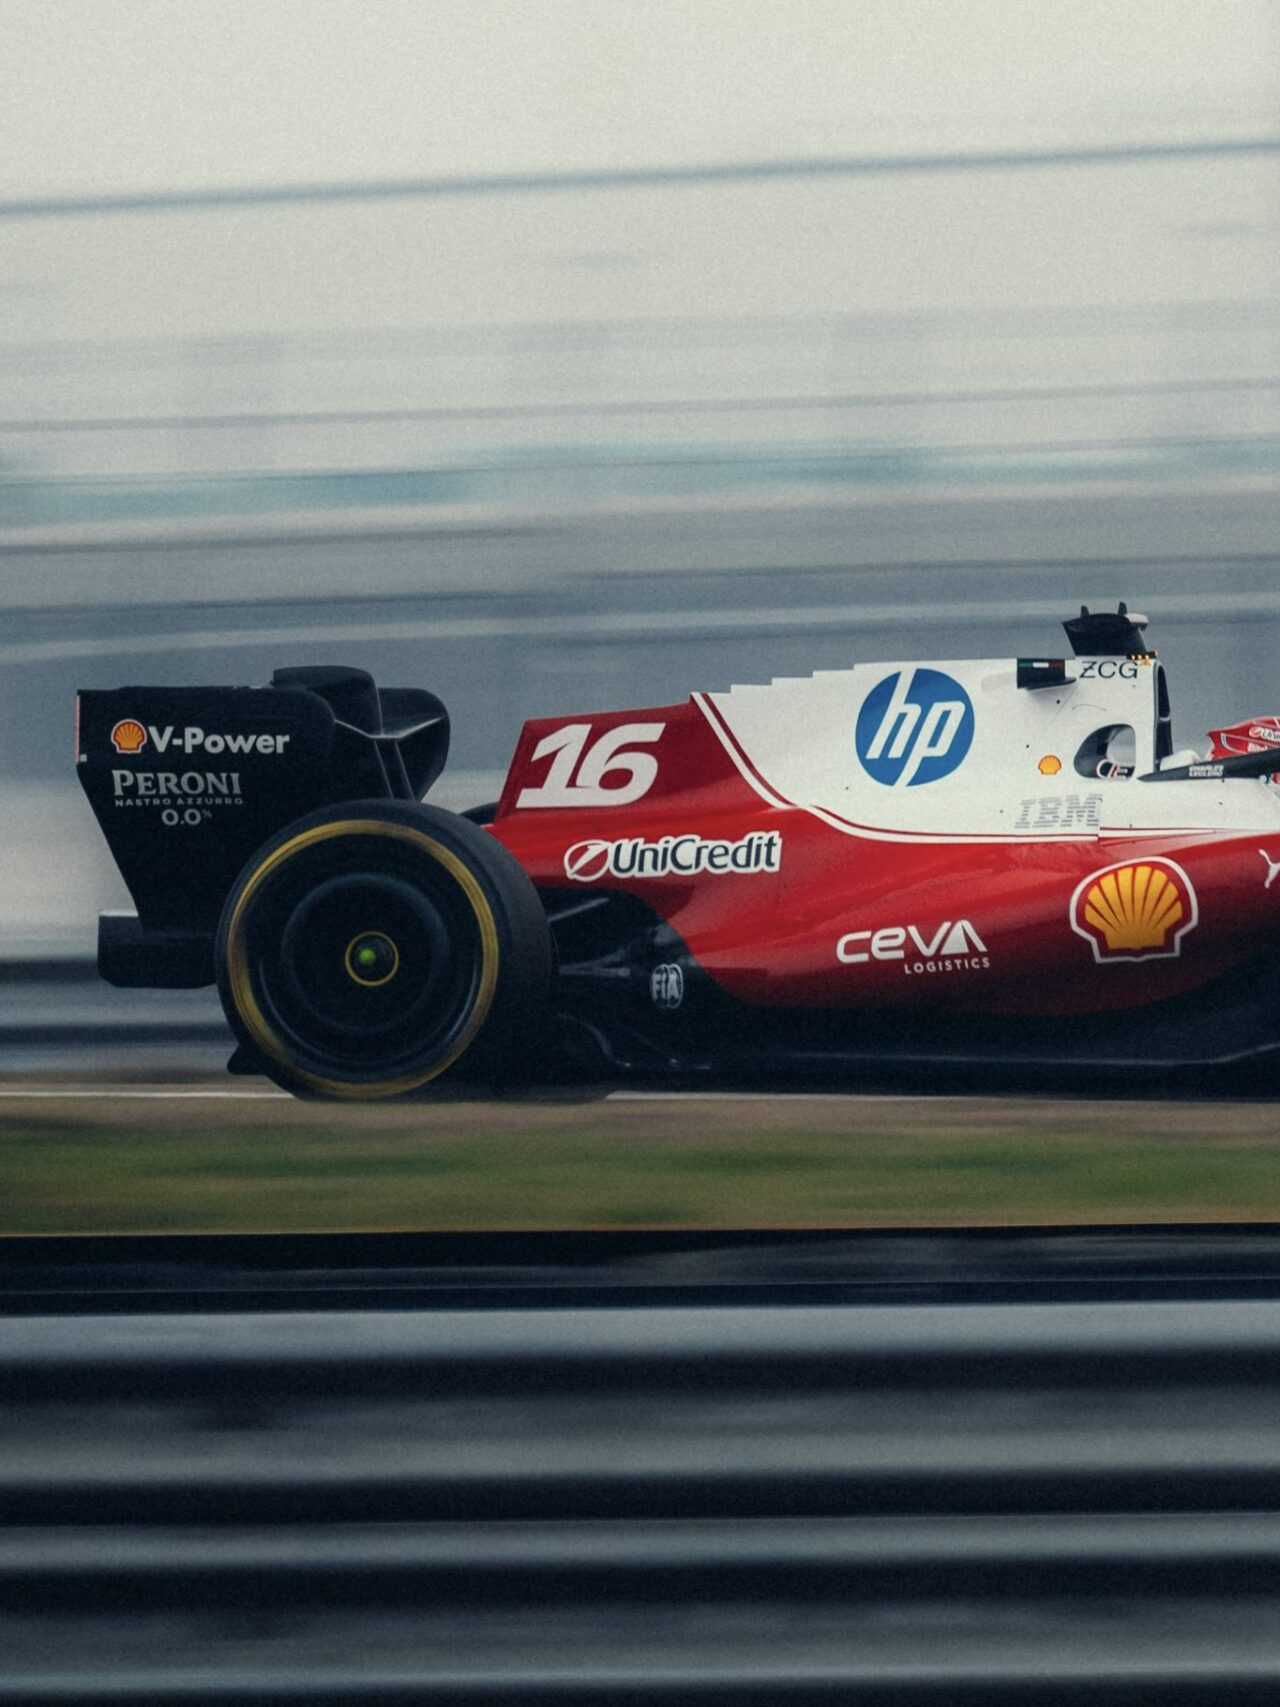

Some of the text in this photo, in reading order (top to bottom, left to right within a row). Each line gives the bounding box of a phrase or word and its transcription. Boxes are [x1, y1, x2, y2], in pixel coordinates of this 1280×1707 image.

[1079, 661, 1138, 679] ZCG
[148, 726, 290, 754] V-Power
[865, 668, 968, 787] hp
[515, 722, 666, 809] 16
[111, 769, 242, 796] PERONI
[114, 797, 243, 807] NASTRO AZZURRO
[1014, 794, 1103, 829] IBM
[612, 835, 778, 874] UniCredit
[904, 957, 990, 975] LOGISTICS
[652, 970, 680, 1002] FIA
